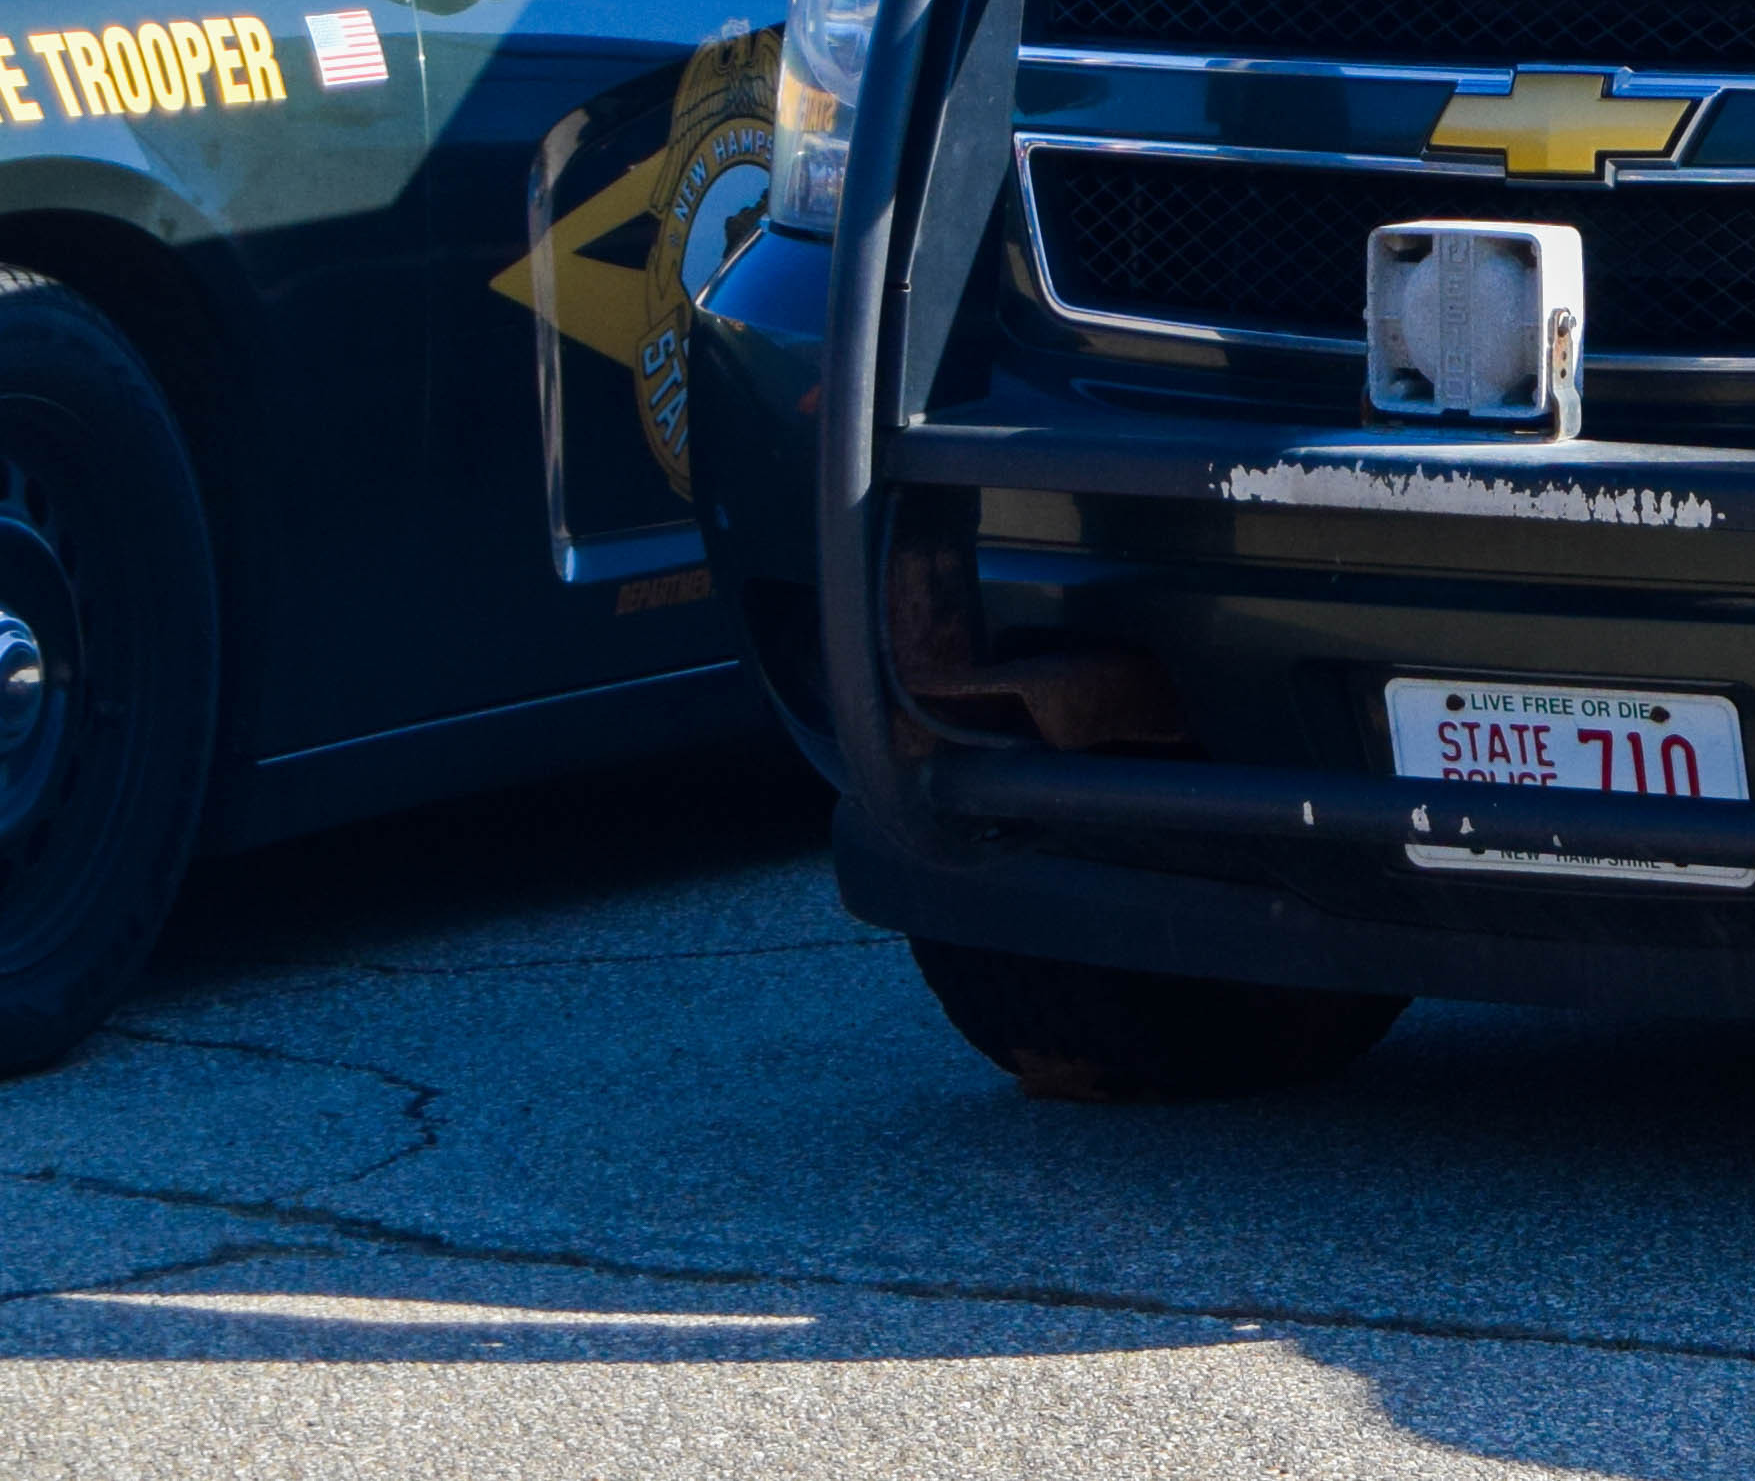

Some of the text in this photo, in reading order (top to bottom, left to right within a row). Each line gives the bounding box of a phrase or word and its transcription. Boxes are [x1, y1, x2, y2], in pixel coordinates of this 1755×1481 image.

[27, 15, 287, 118] TROOPER
[674, 127, 774, 223] NEW HAMPS
[642, 329, 689, 457] STA
[1438, 721, 1556, 768] STATE
[1471, 693, 1651, 720] LIVE FREE OR DIE
[1577, 727, 1701, 798] 710
